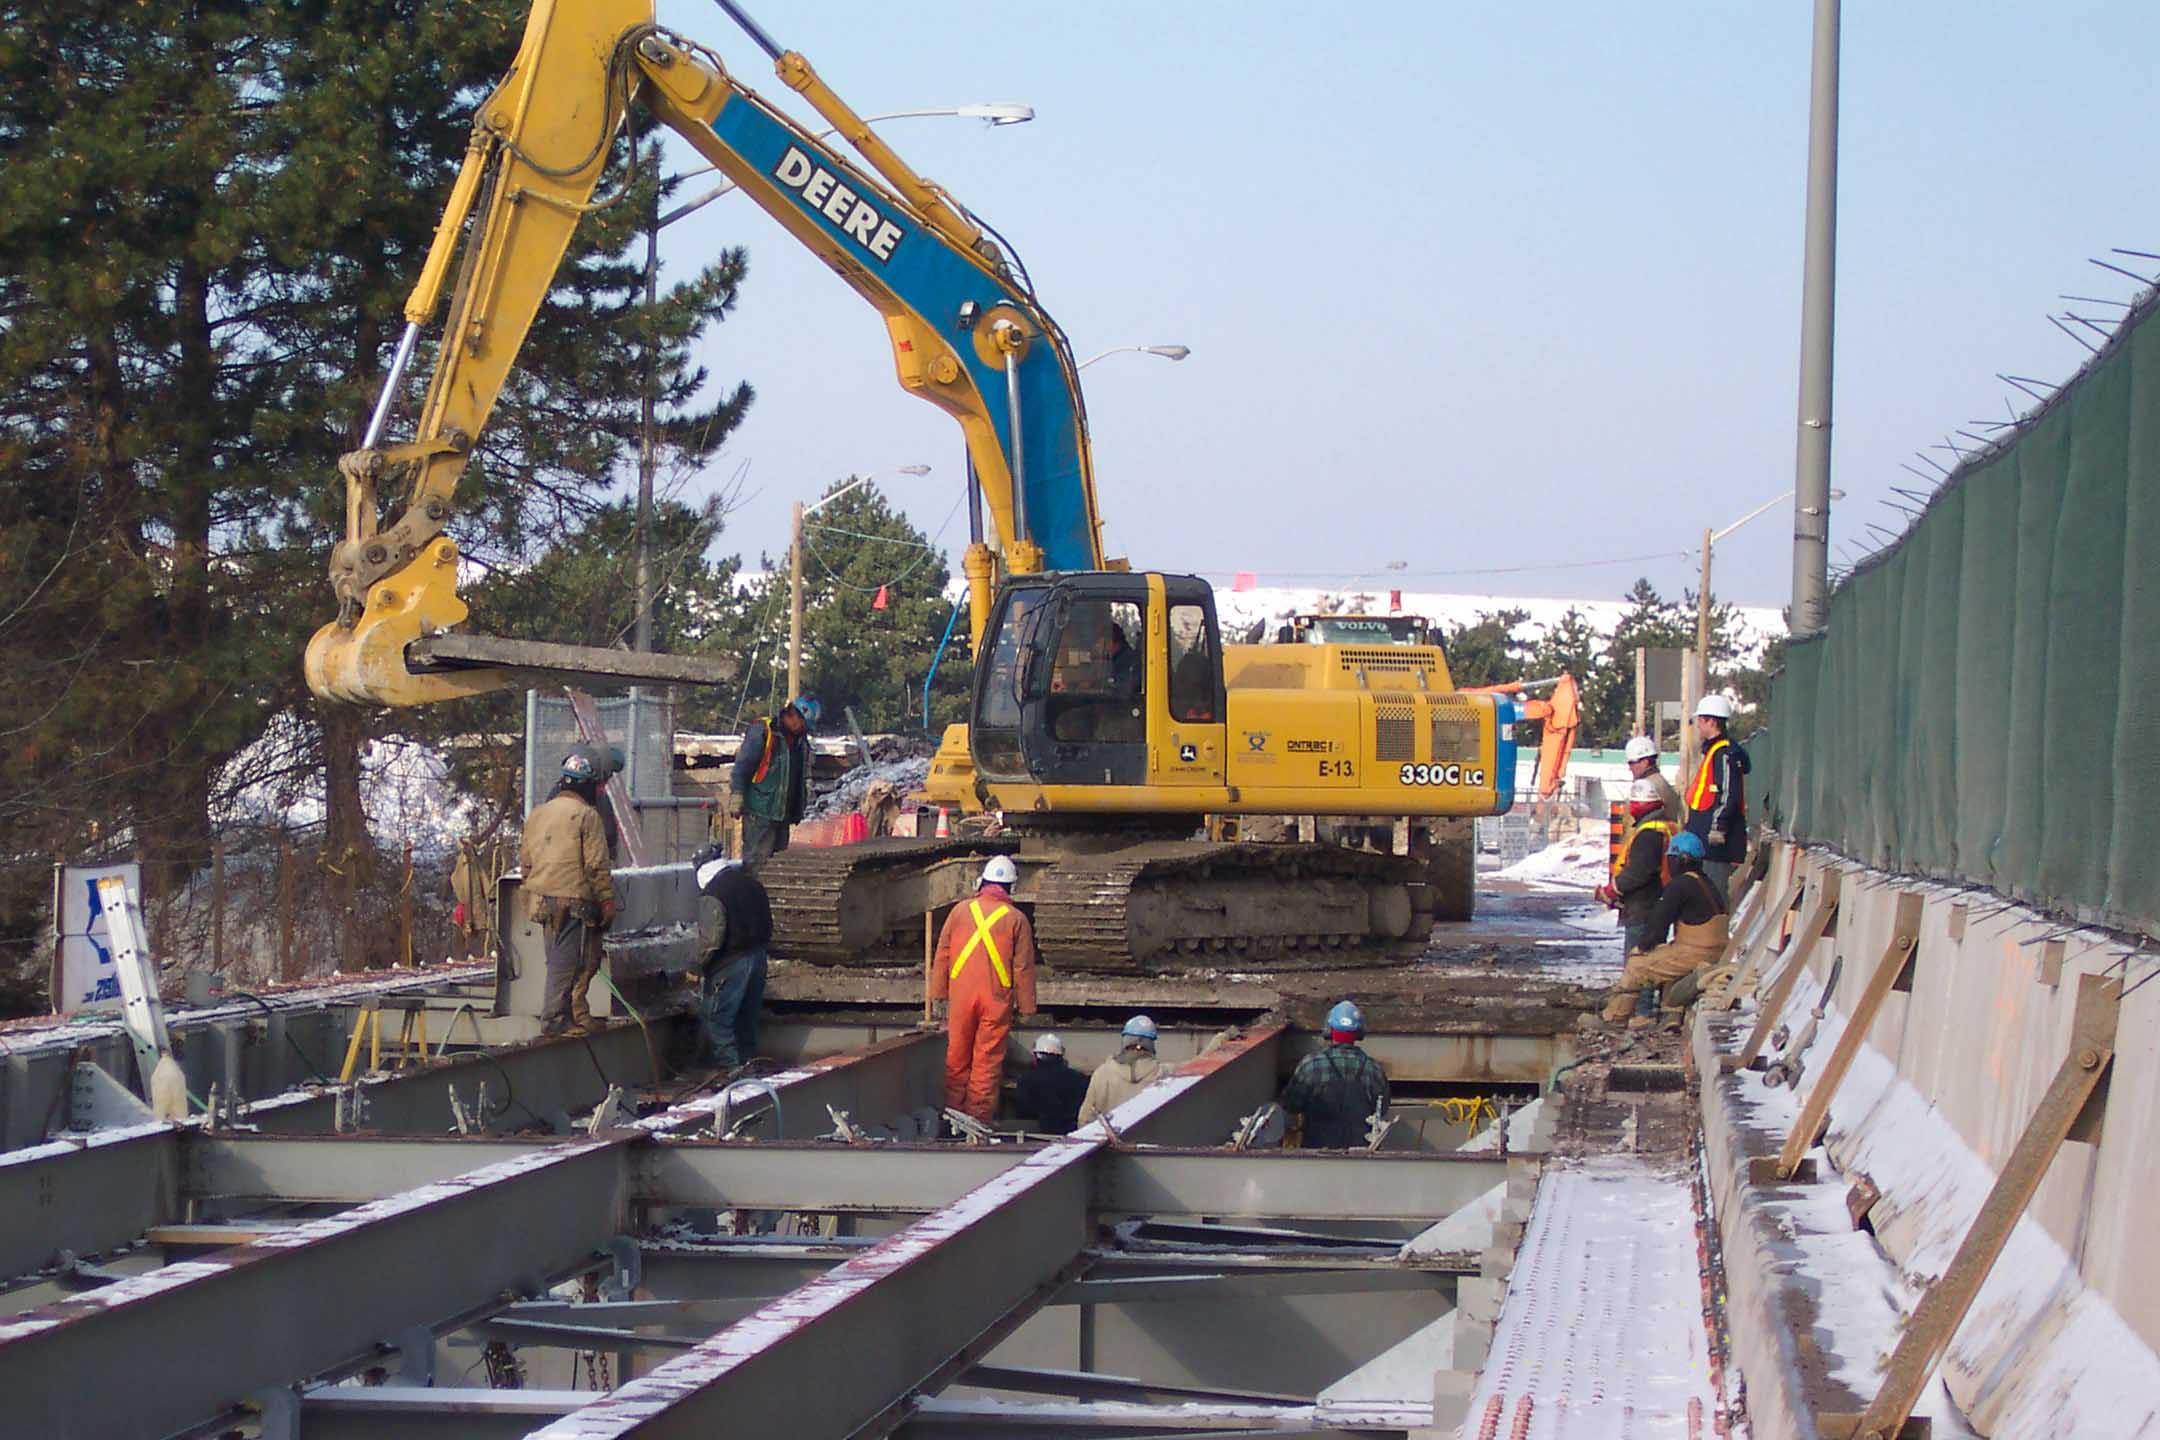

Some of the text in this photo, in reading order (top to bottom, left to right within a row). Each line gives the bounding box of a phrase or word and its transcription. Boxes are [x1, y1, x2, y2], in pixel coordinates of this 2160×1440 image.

[774, 145, 904, 262] DEERE
[1336, 620, 1388, 632] VOLVO
[1318, 760, 1353, 777] E-13
[1400, 763, 1484, 785] 330C LC
